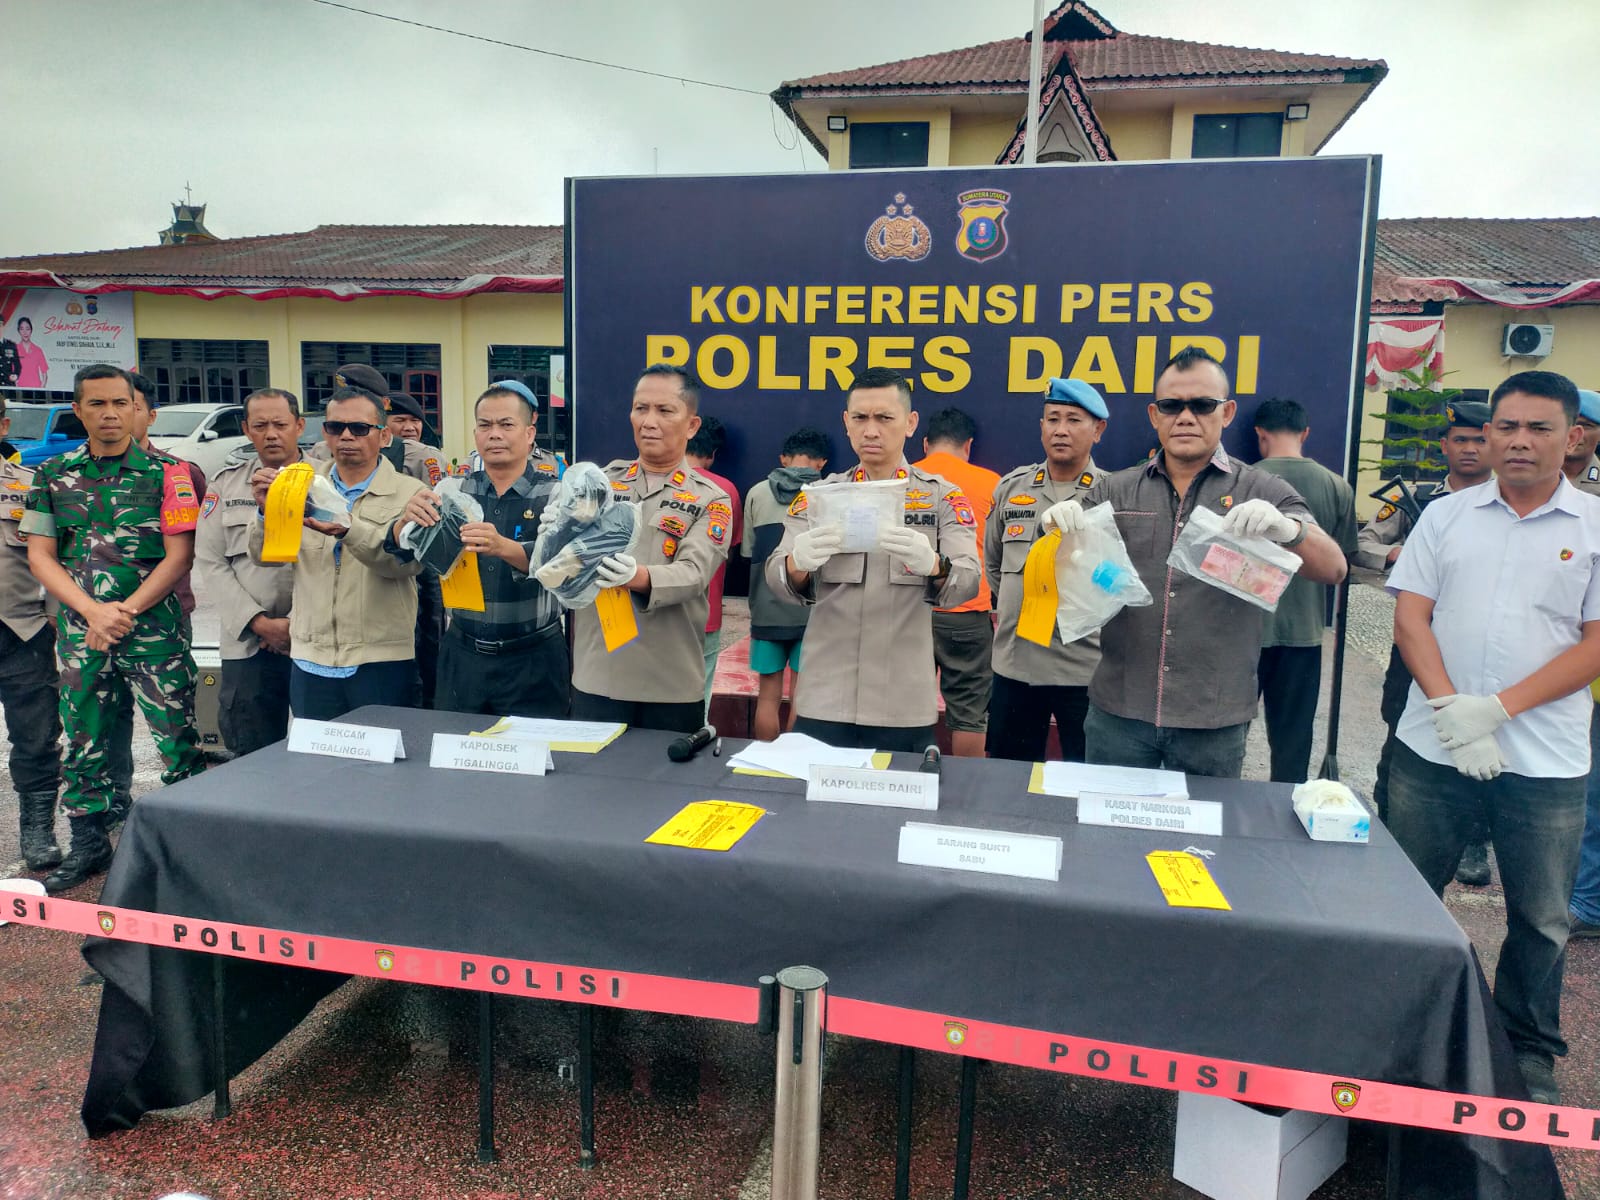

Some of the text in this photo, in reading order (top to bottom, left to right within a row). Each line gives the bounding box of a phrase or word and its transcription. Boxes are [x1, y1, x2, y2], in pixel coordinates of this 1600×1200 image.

[690, 282, 1213, 324] KONFERENSI PERS
[43, 316, 82, 335] Selamat
[646, 334, 972, 393] POLRES
[660, 500, 701, 518] POLRI
[904, 514, 936, 526] OLRI
[324, 727, 366, 740] SEKCAM
[311, 742, 371, 757] TIGALINGGA
[460, 740, 518, 753] KAPOLSEK
[454, 758, 519, 771] TIGALINGGA
[821, 778, 922, 794] KAPOLRES DAIRI
[1104, 799, 1192, 816] KASAT NARKOBA
[1110, 813, 1185, 829] POLRES DAIRI
[937, 838, 1011, 853] BARANG BUKTI
[959, 854, 985, 865] SABU
[0, 898, 46, 921] SI
[173, 923, 315, 961] POLISI
[461, 961, 620, 999] POLISI
[1049, 1042, 1248, 1094] POLISI
